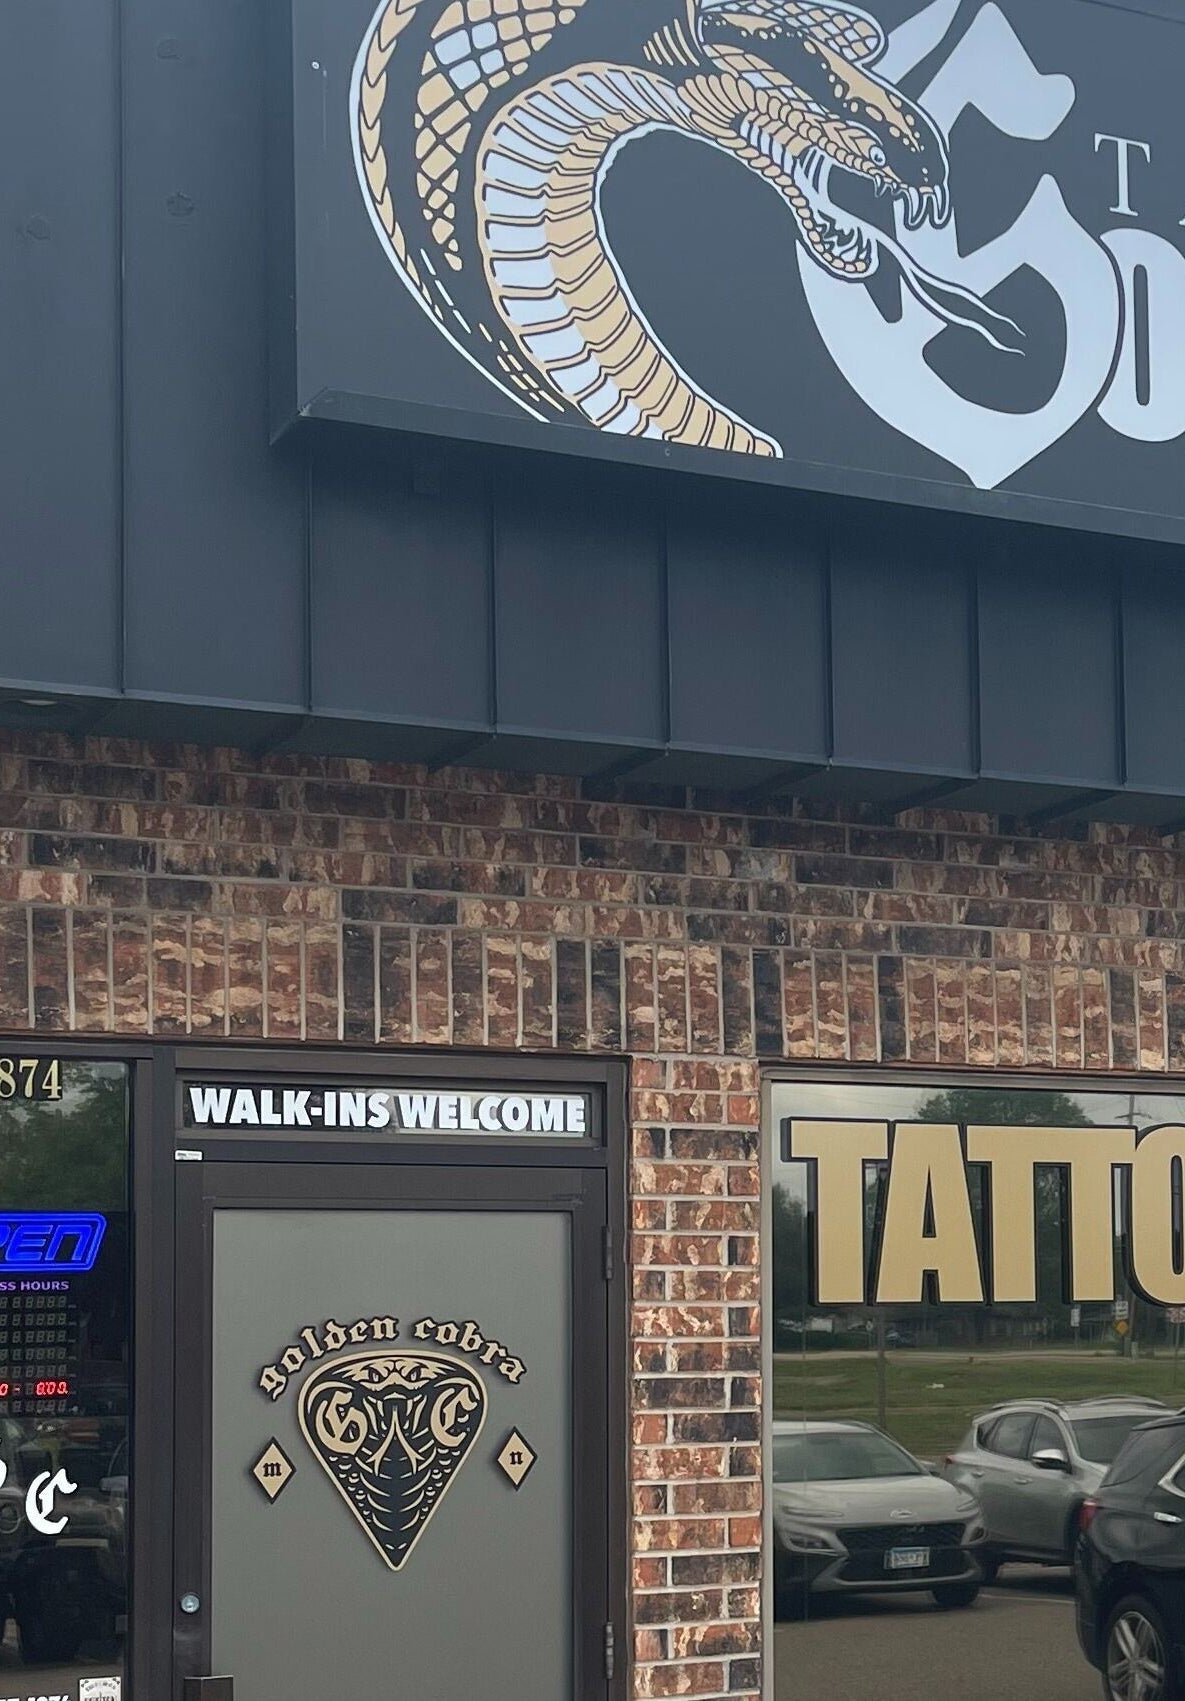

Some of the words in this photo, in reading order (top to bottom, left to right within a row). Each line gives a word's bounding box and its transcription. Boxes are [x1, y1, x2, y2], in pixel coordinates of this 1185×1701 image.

[189, 1087, 391, 1129] WALK-INS
[399, 1092, 587, 1133] WELCOME
[20, 1280, 69, 1291] HOURS
[259, 1314, 400, 1401] golden
[413, 1315, 528, 1385] cobra
